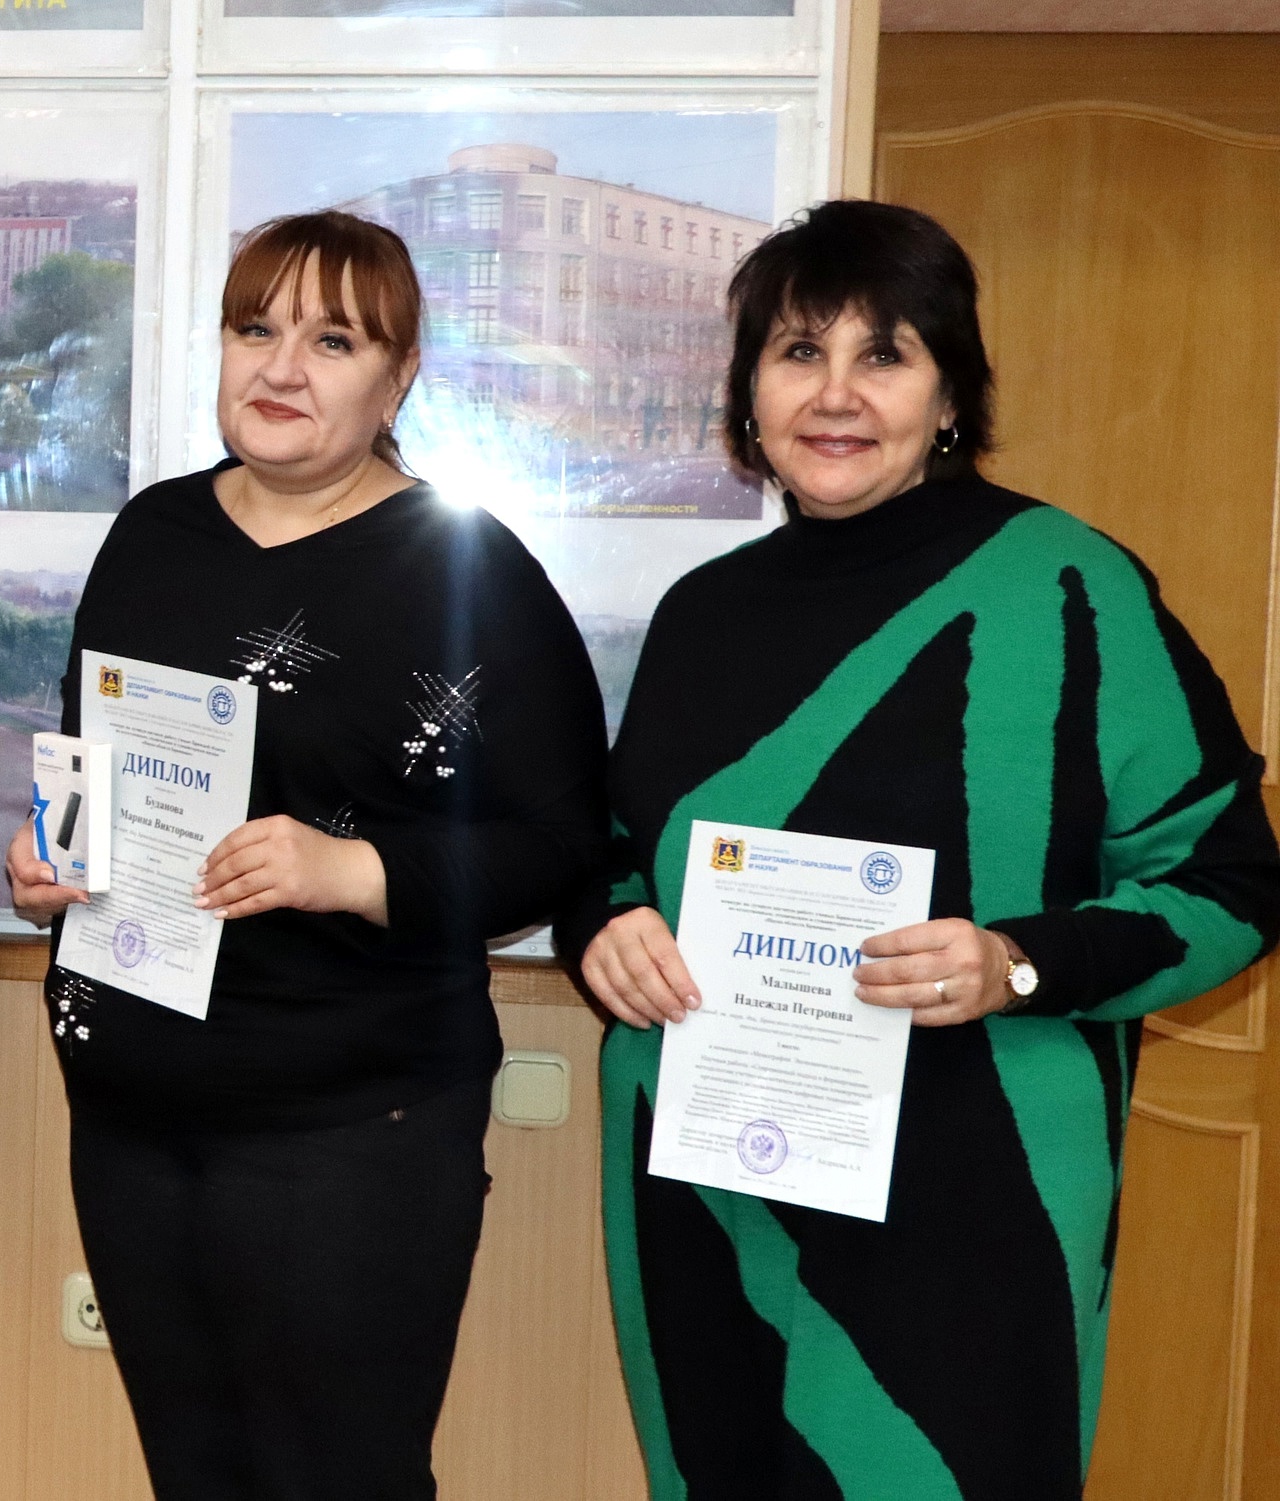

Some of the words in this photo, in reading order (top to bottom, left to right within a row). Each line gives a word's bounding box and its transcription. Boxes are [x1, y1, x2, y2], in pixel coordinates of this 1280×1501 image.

[122, 752, 211, 793] ДИПЛОМ
[120, 808, 153, 827] Марина
[154, 818, 204, 842] Викторовна
[733, 932, 862, 969] ДИПЛОМ
[761, 975, 832, 997] Малышева
[734, 993, 789, 1012] Надежда
[792, 1002, 854, 1023] Петровна
